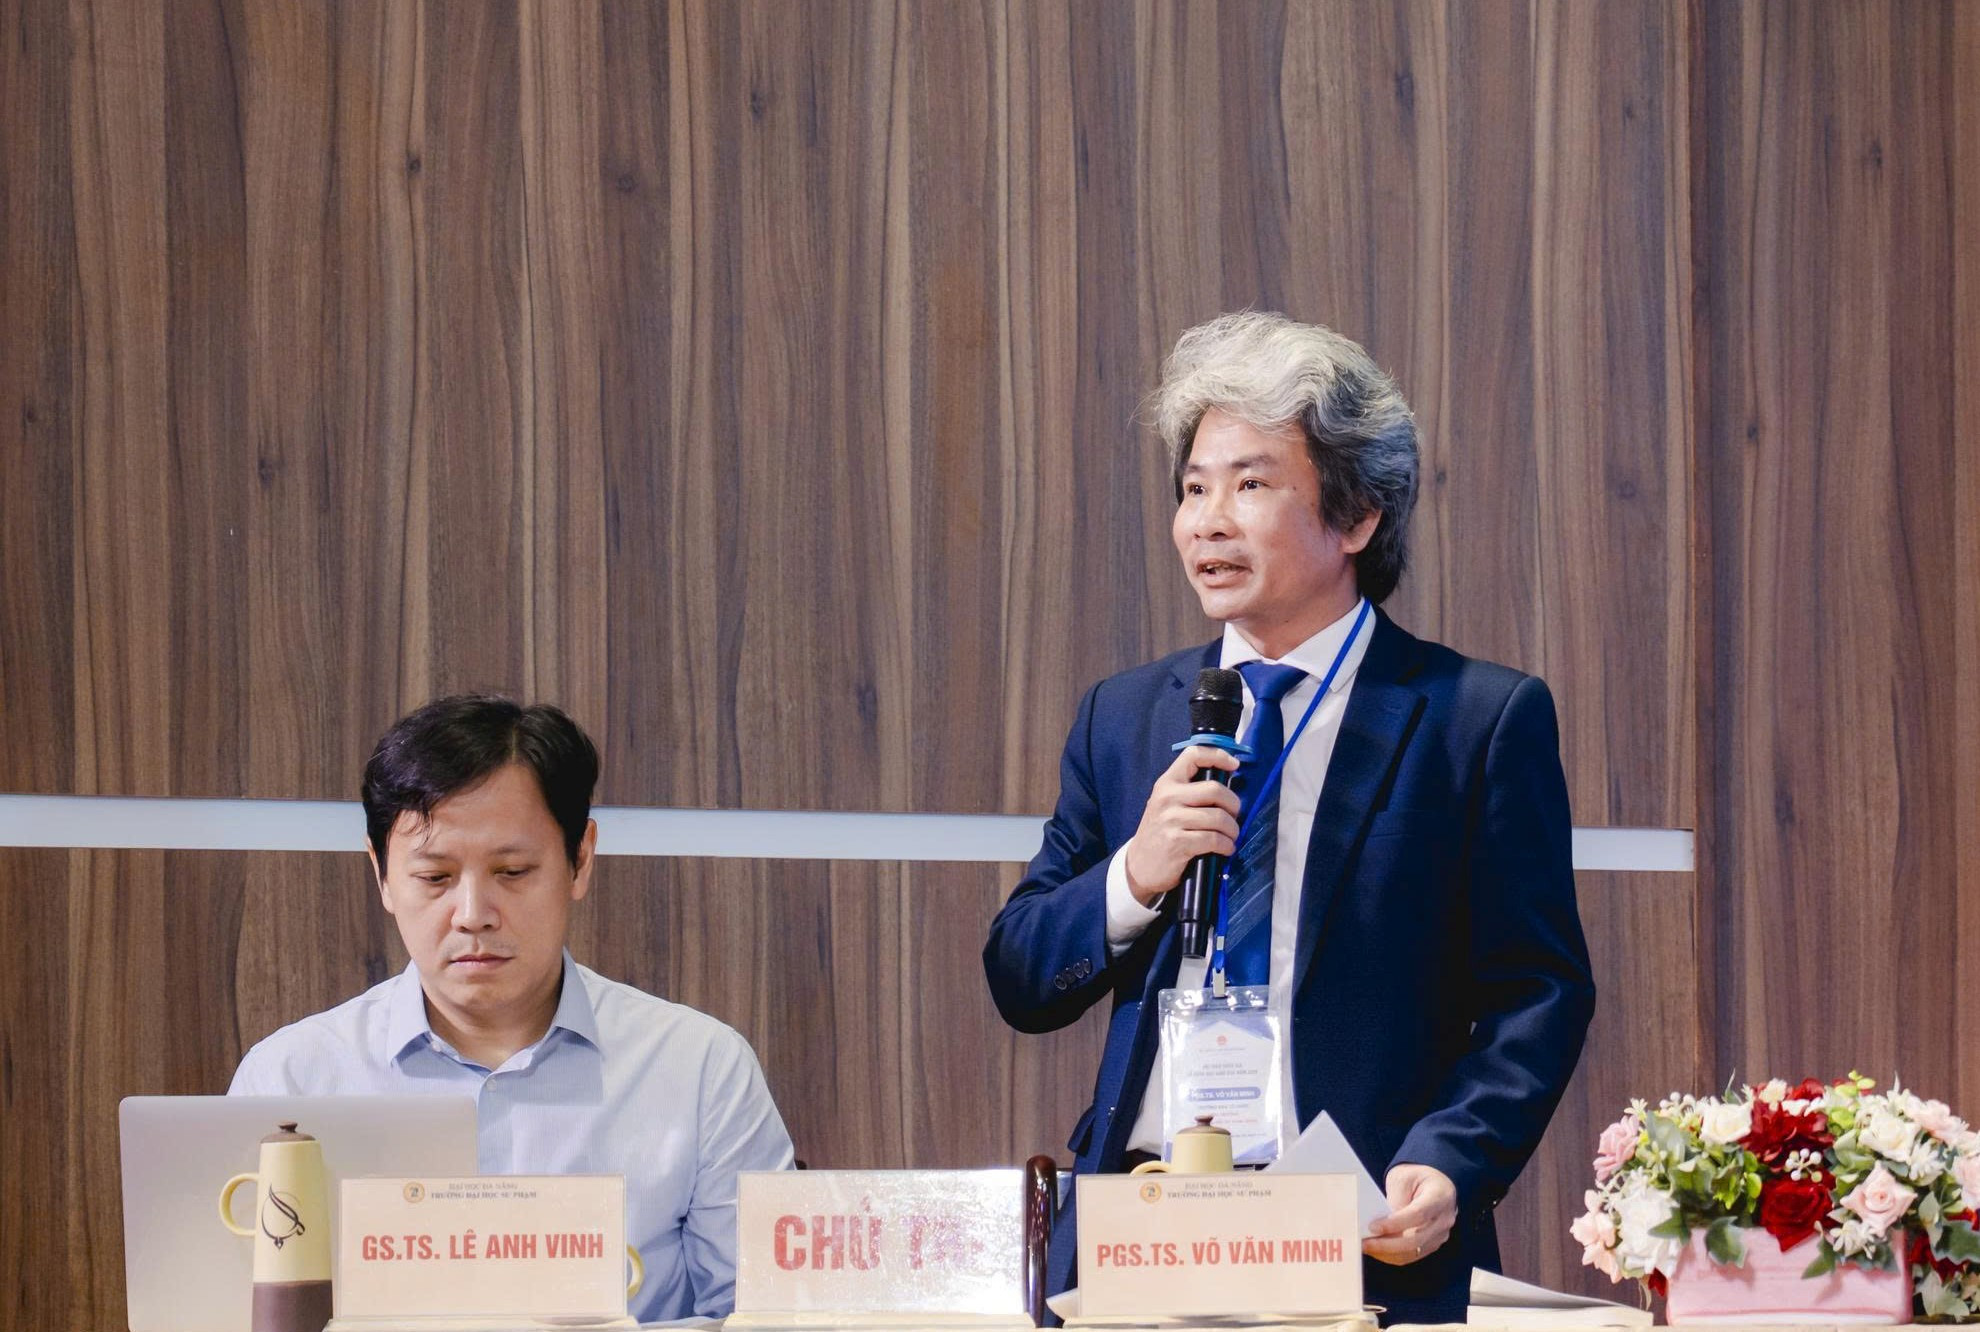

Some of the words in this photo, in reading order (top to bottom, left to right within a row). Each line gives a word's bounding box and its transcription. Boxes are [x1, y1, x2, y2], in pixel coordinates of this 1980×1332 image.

[362, 1235, 440, 1261] GS.TS.
[449, 1229, 476, 1260] LÊ
[485, 1234, 537, 1259] ANH
[545, 1233, 603, 1259] VINH
[774, 1196, 881, 1271] CHỦ
[1097, 1242, 1185, 1267] PGS.TS.
[1192, 1237, 1221, 1265] VÕ
[1228, 1237, 1274, 1264] VĂN
[1282, 1239, 1343, 1263] MINH
